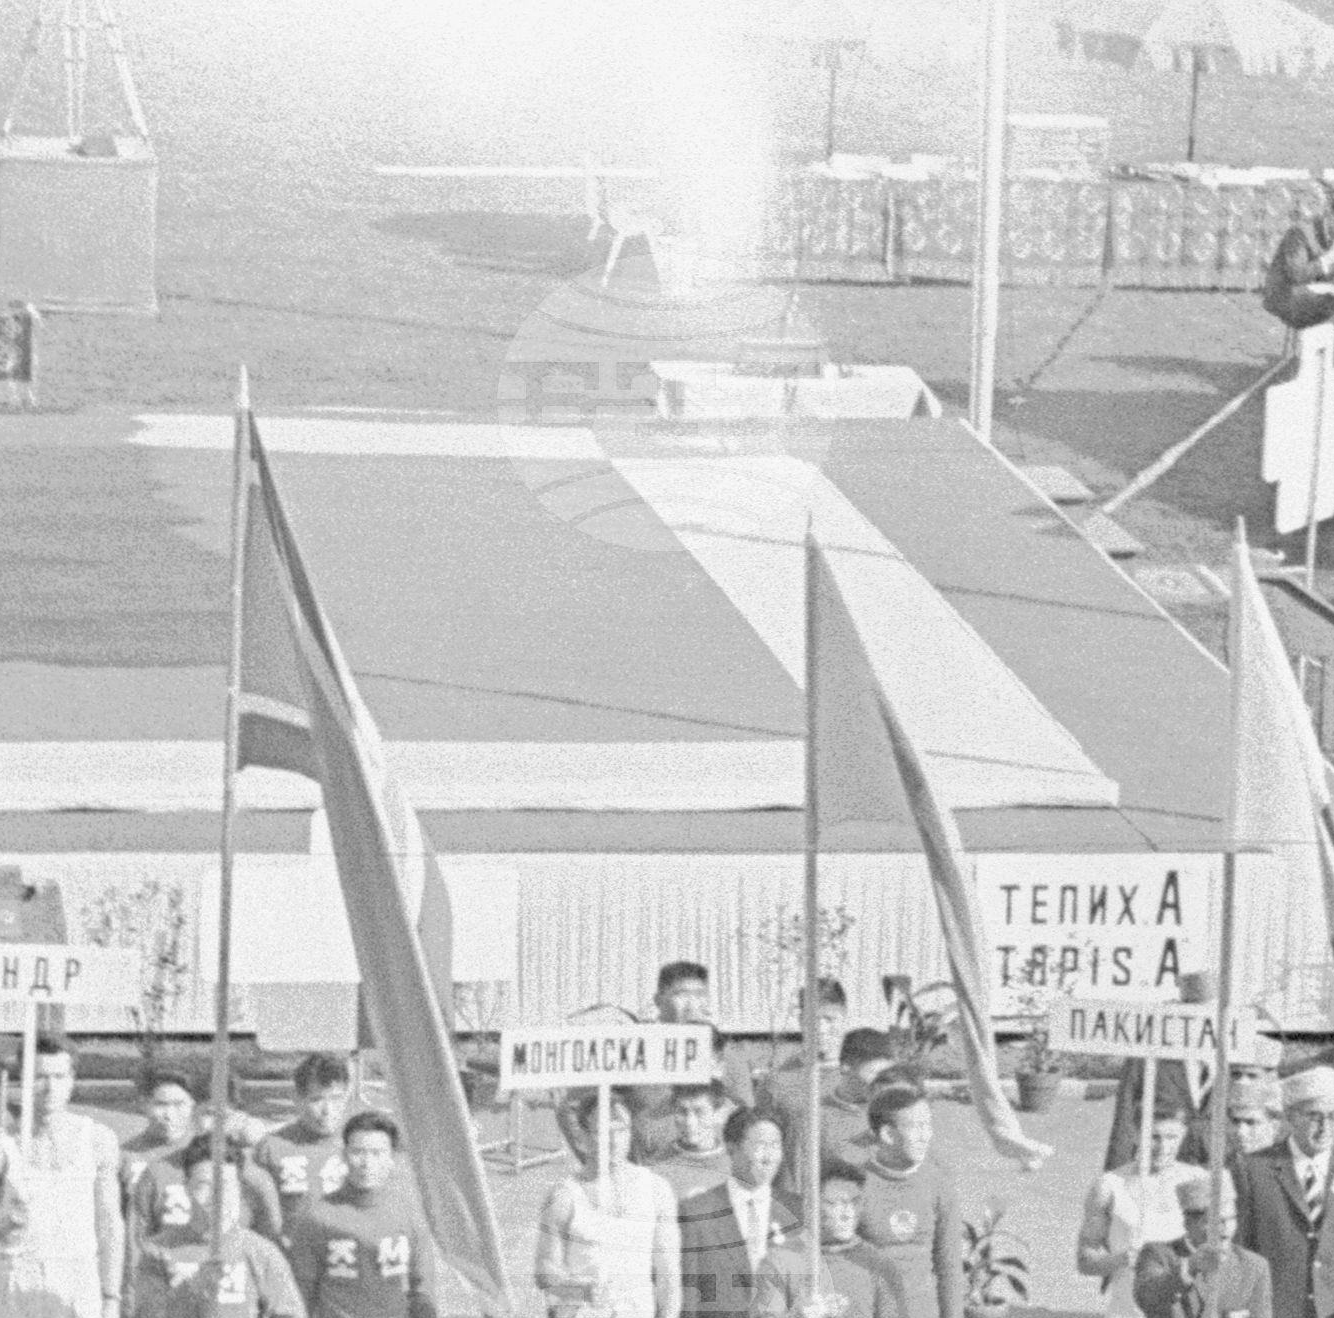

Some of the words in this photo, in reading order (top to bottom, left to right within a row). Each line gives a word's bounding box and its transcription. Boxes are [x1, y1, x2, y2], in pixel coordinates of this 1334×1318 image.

[999, 885, 1139, 925] ТЕПИХ
[1156, 869, 1182, 926] А
[511, 1037, 647, 1075] МОНГОЛСКА
[663, 1037, 698, 1072] НР
